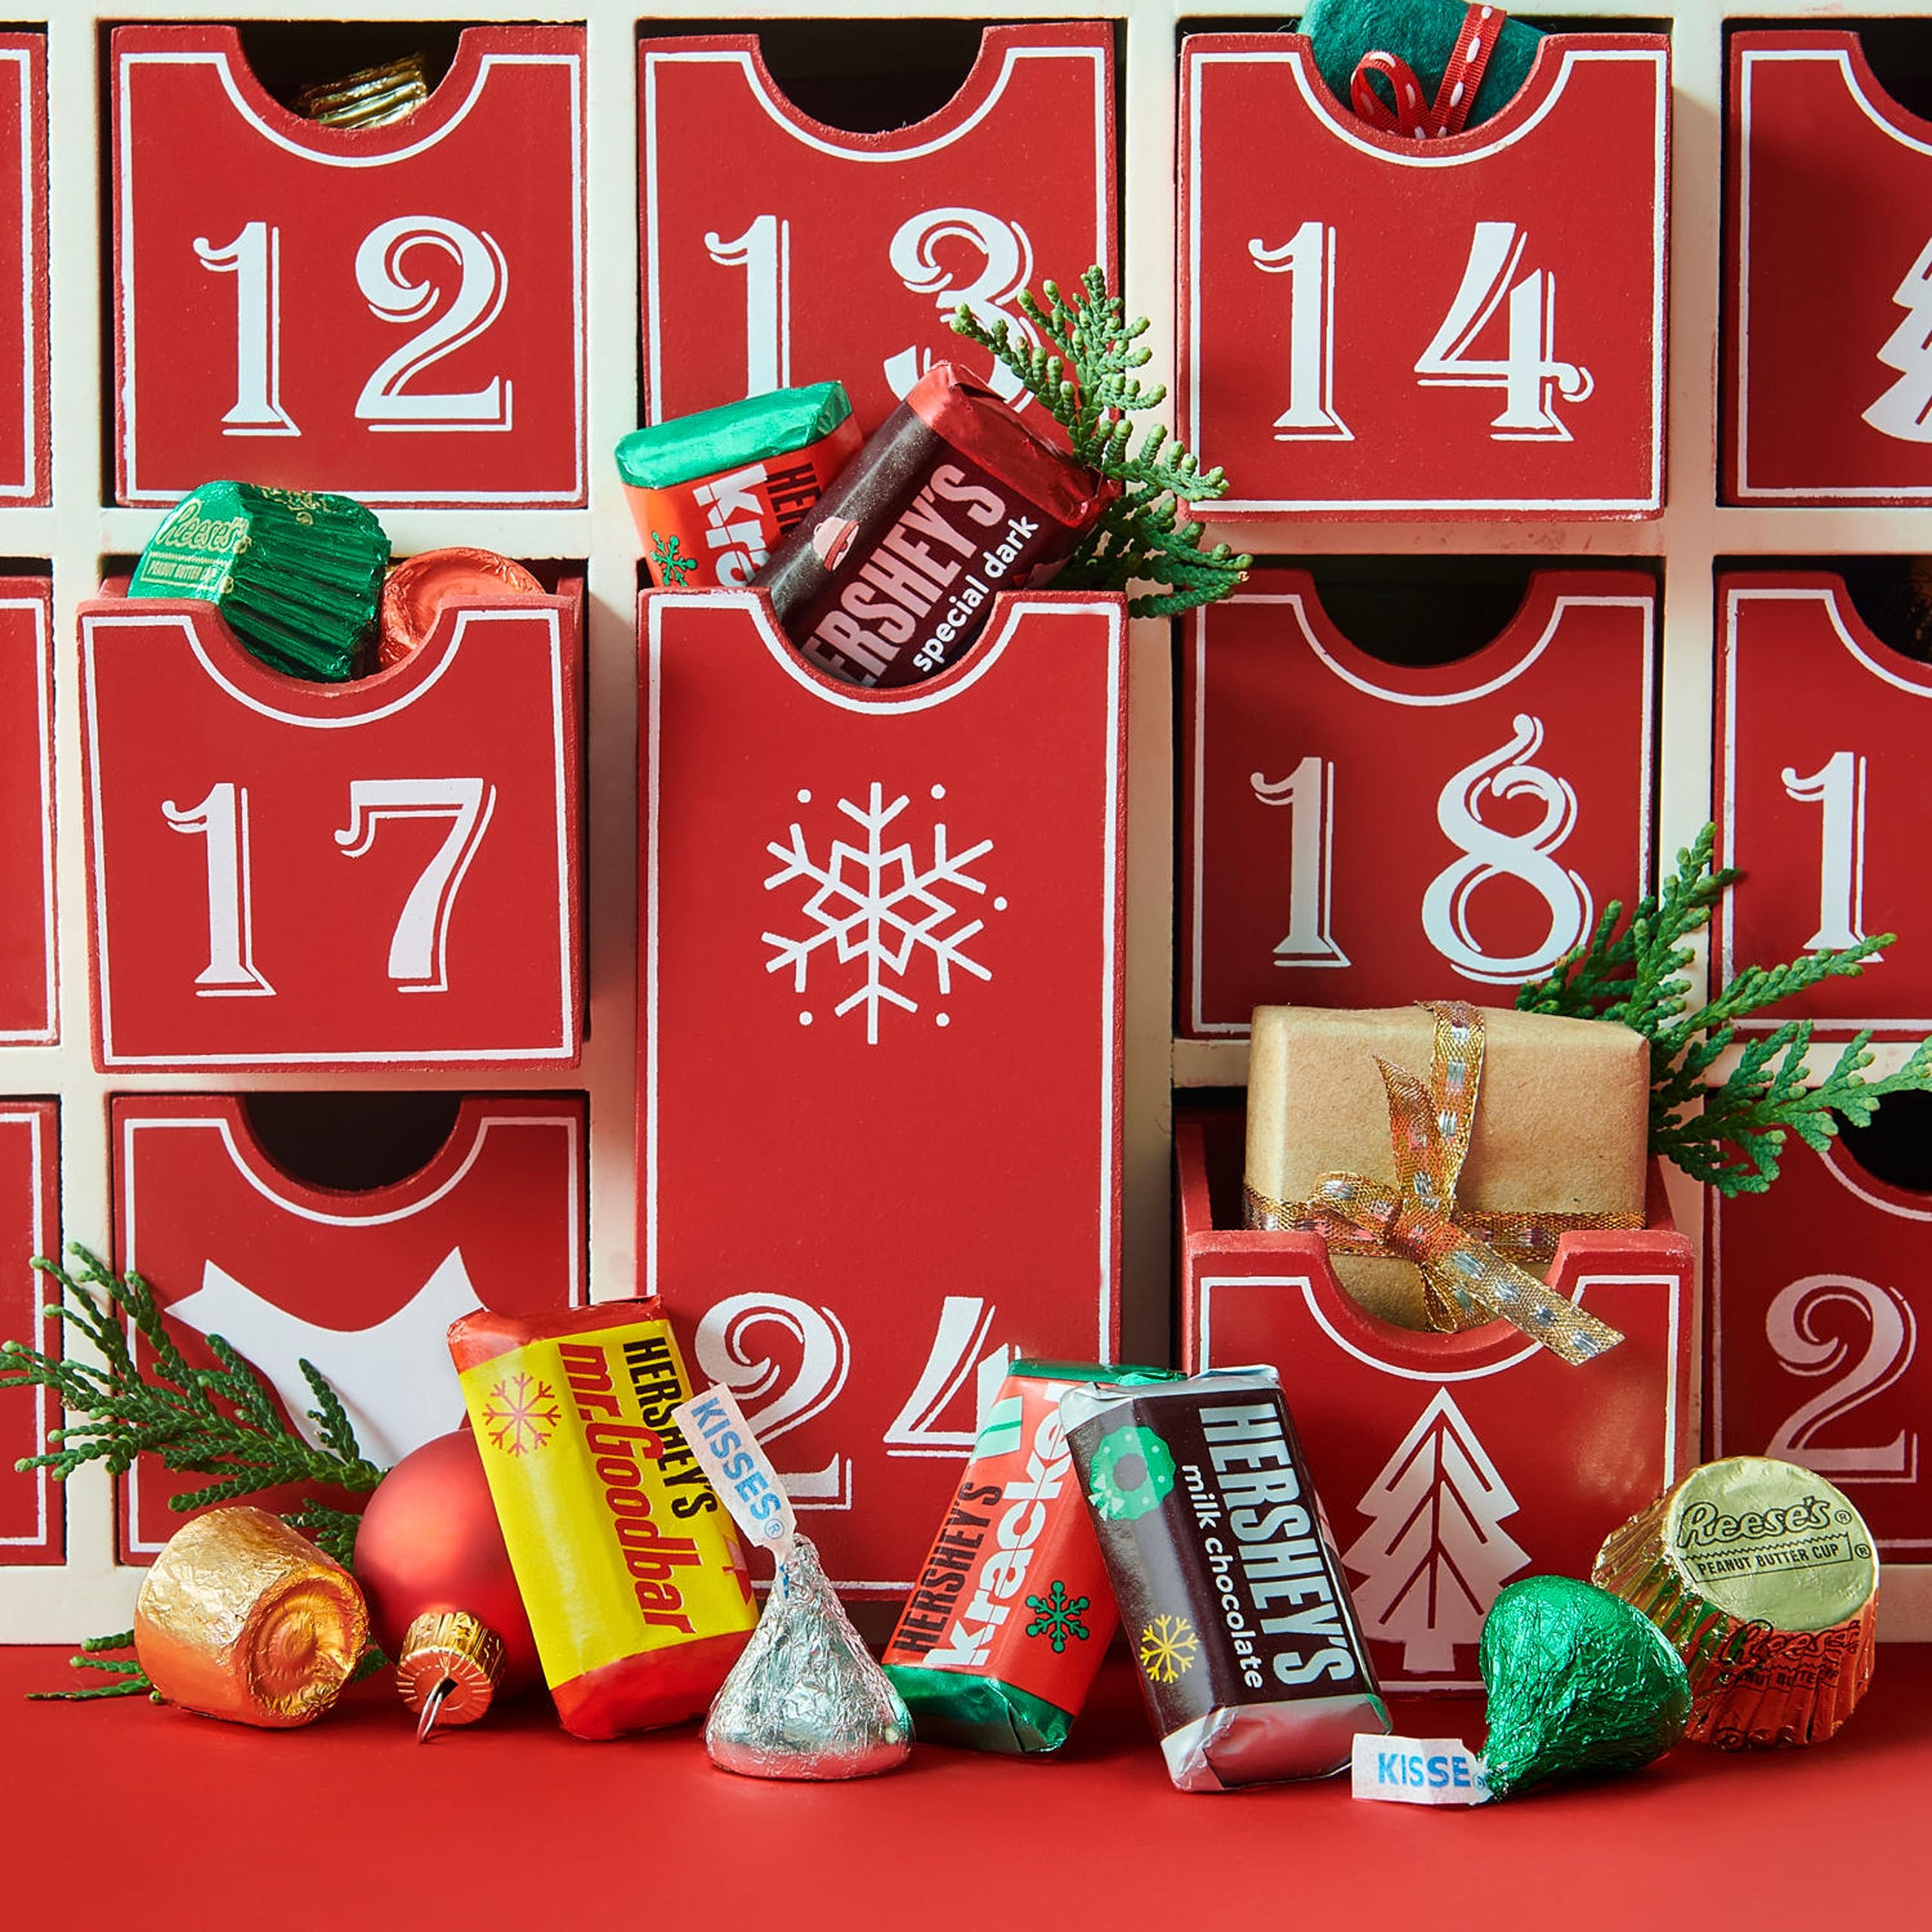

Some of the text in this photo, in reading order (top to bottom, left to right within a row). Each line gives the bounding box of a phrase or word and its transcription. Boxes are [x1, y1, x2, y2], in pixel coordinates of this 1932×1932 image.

[192, 215, 513, 436] 12
[704, 207, 1043, 412] 13
[1247, 222, 1595, 441] 14
[155, 497, 250, 554] Reese's
[913, 515, 1039, 671] special dark
[162, 778, 497, 997] 17
[1250, 713, 1594, 985] 18
[1781, 752, 1884, 963] 1
[623, 1337, 718, 1519] HERSHEY'S
[694, 1291, 1022, 1510] 24
[1764, 1274, 1917, 1483] 2
[894, 1481, 1003, 1654] HERSHEY'S
[1181, 1464, 1263, 1689] milk chocolate
[1198, 1402, 1356, 1685] HERSHEY'S
[1677, 1495, 1831, 1548] Reese's
[1698, 1543, 1839, 1577] PEANUT BUTTER CUP
